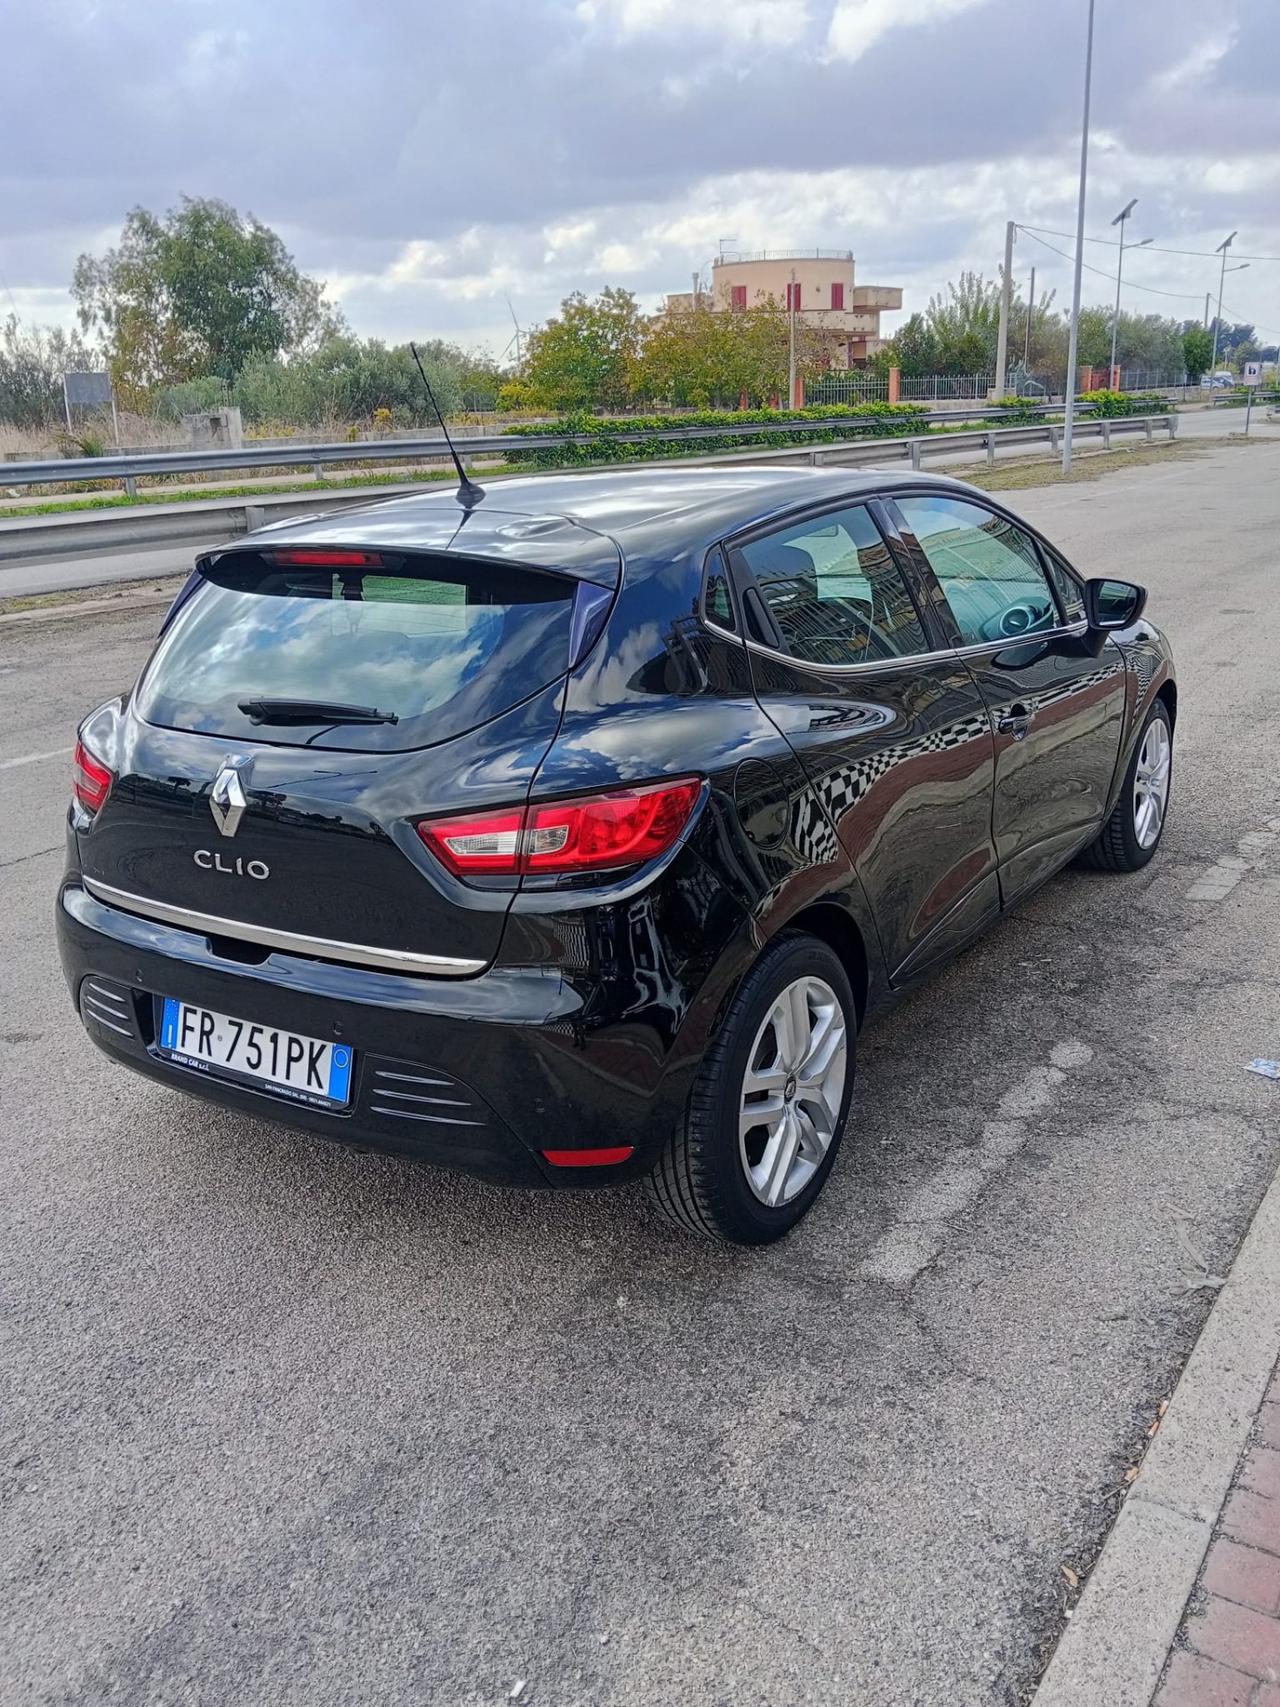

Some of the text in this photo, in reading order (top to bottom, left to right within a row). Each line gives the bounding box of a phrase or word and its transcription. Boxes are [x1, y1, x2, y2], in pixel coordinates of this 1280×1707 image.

[193, 849, 270, 880] CLIO
[180, 1005, 327, 1090] FR 751PK
